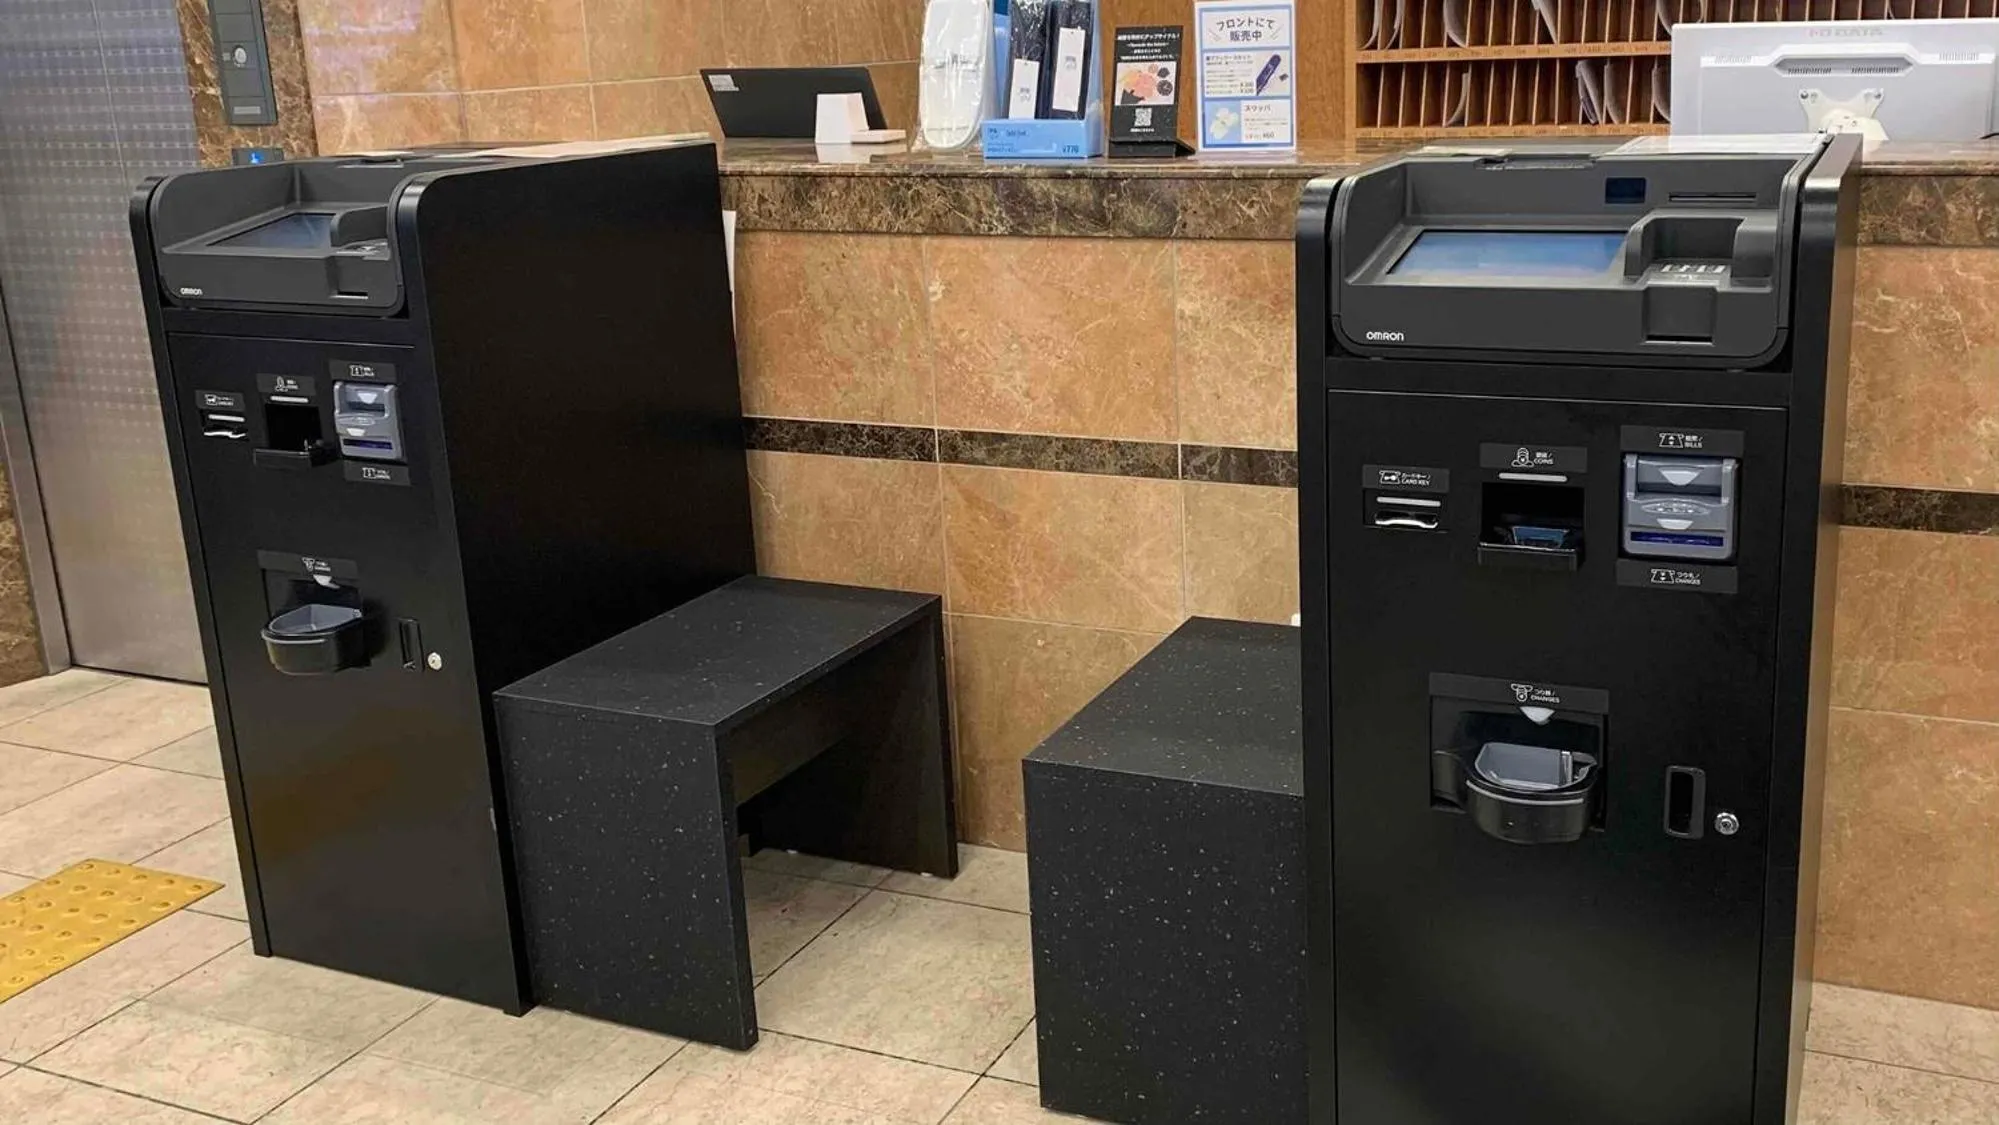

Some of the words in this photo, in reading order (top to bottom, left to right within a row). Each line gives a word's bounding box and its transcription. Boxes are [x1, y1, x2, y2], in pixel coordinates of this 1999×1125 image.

[1216, 18, 1276, 31] フロントにて
[1229, 30, 1262, 41] 販売中
[1366, 331, 1404, 341] OMRON
